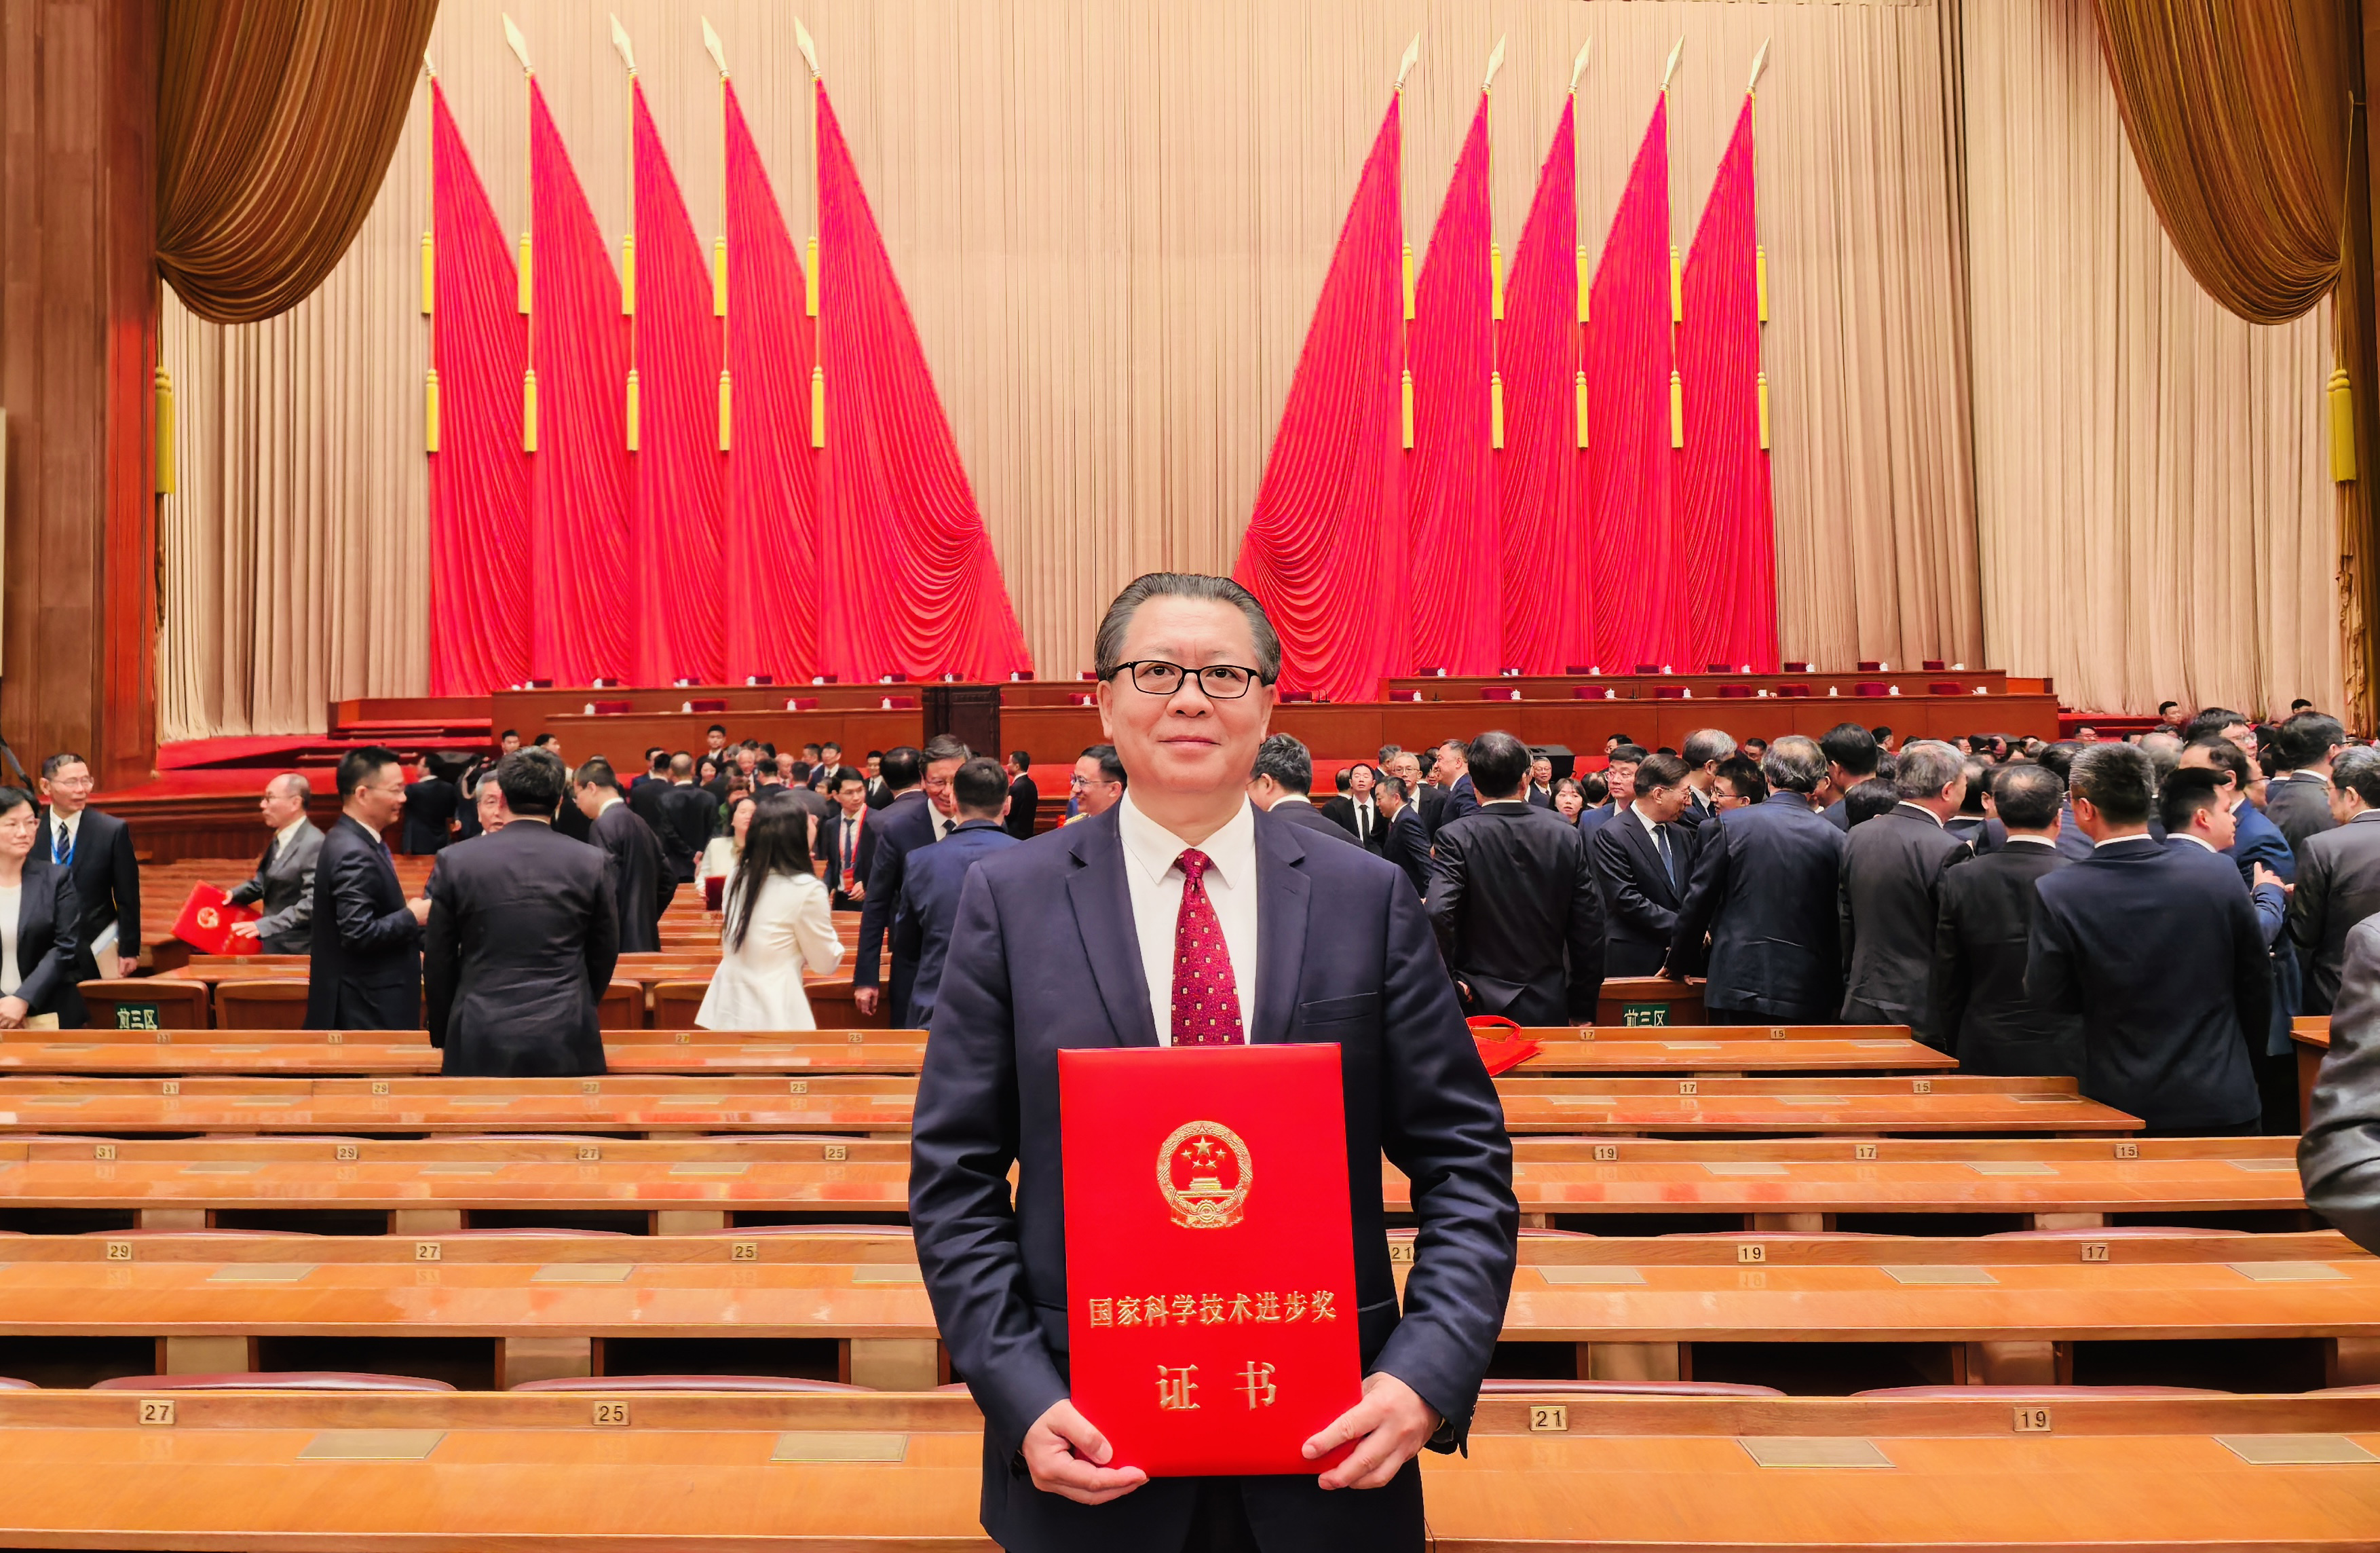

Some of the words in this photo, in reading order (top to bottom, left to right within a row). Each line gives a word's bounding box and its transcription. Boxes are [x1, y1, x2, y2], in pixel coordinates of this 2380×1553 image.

[166, 1084, 177, 1092] 31
[375, 1084, 387, 1092] 29
[1682, 1084, 1695, 1092] 17
[1916, 1083, 1929, 1091] 15
[98, 1148, 112, 1158] 31
[340, 1148, 354, 1157] 29
[582, 1148, 596, 1158] 27
[828, 1148, 843, 1158] 25
[1600, 1148, 1614, 1158] 19
[1859, 1148, 1874, 1157] 17
[2121, 1146, 2135, 1156] 15
[111, 1246, 128, 1257] 29
[419, 1246, 438, 1258] 27
[736, 1246, 754, 1257] 25
[1392, 1247, 1411, 1259] 21
[1742, 1248, 1761, 1259] 19
[2087, 1246, 2106, 1258] 17
[1089, 1290, 1336, 1328] 国家科学技术进步奖
[1155, 1361, 1277, 1410] 证书
[145, 1404, 170, 1421] 27
[599, 1406, 623, 1421] 25
[1536, 1410, 1562, 1427] 21
[2021, 1410, 2046, 1427] 19
